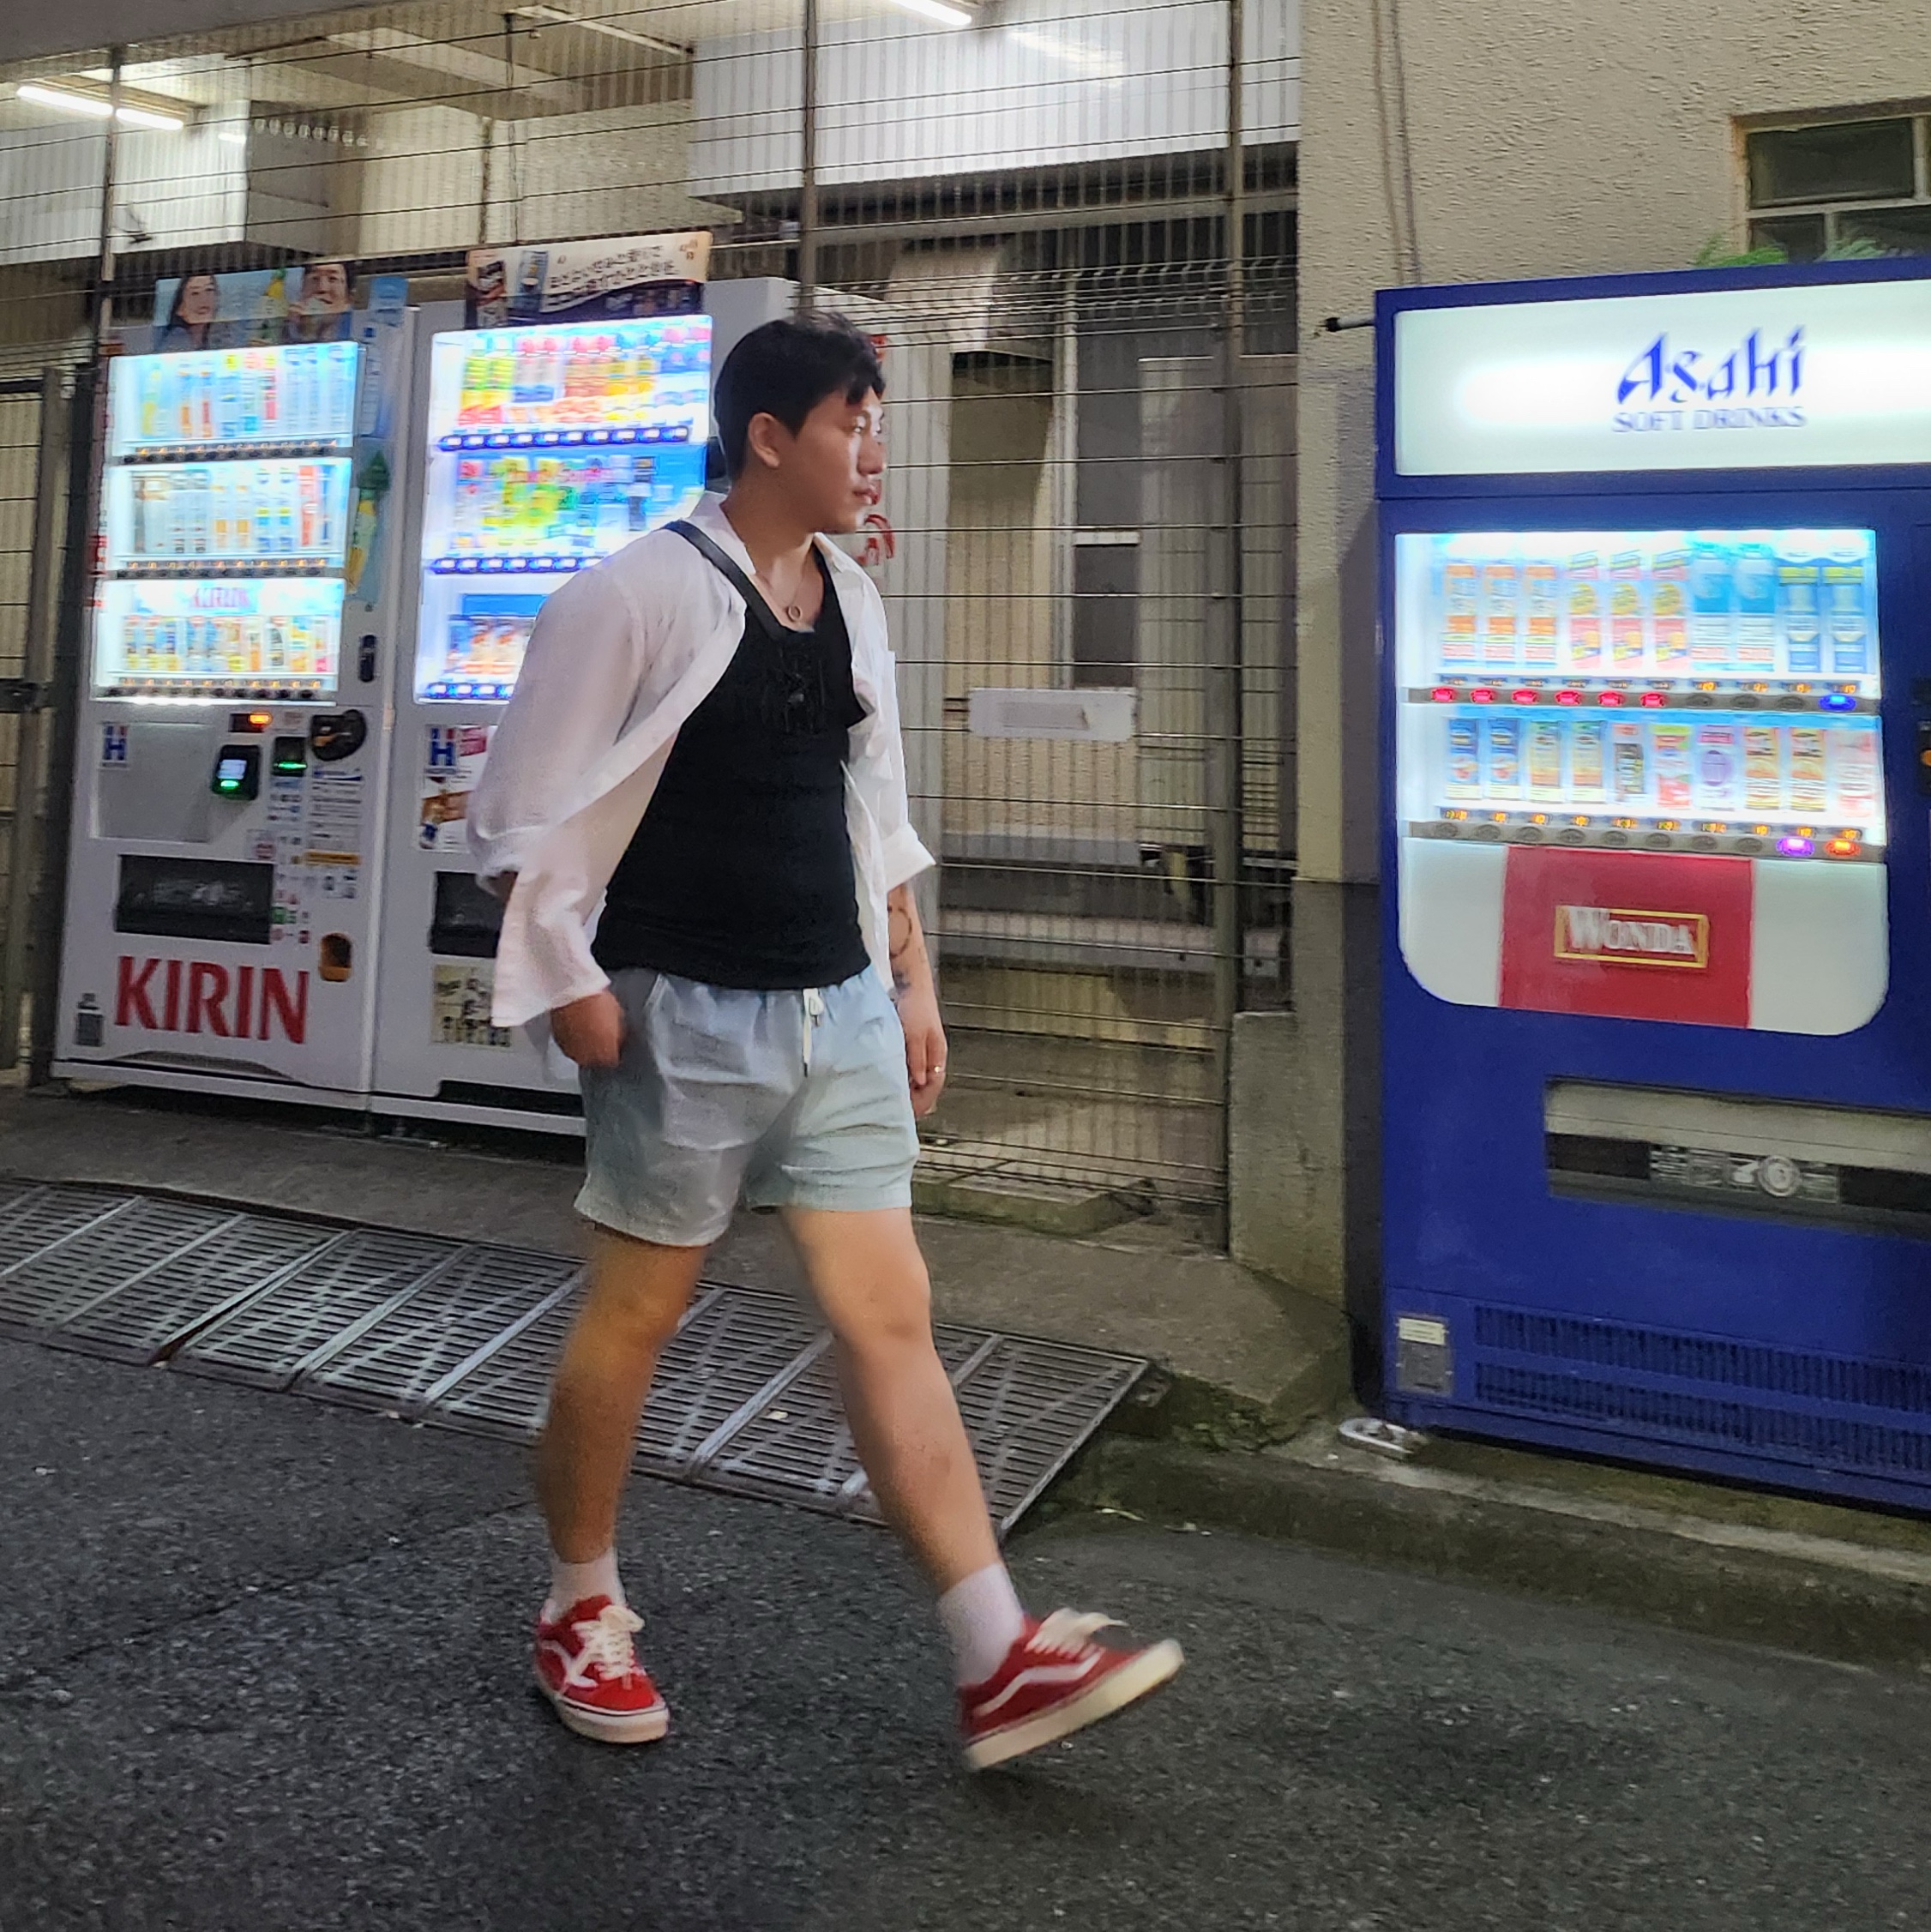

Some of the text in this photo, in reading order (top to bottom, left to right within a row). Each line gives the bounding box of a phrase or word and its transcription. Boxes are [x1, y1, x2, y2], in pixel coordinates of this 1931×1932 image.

[1617, 325, 1805, 404] Asahi
[1612, 406, 1807, 432] SOFT DRINKS
[114, 955, 310, 1044] KIRIN
